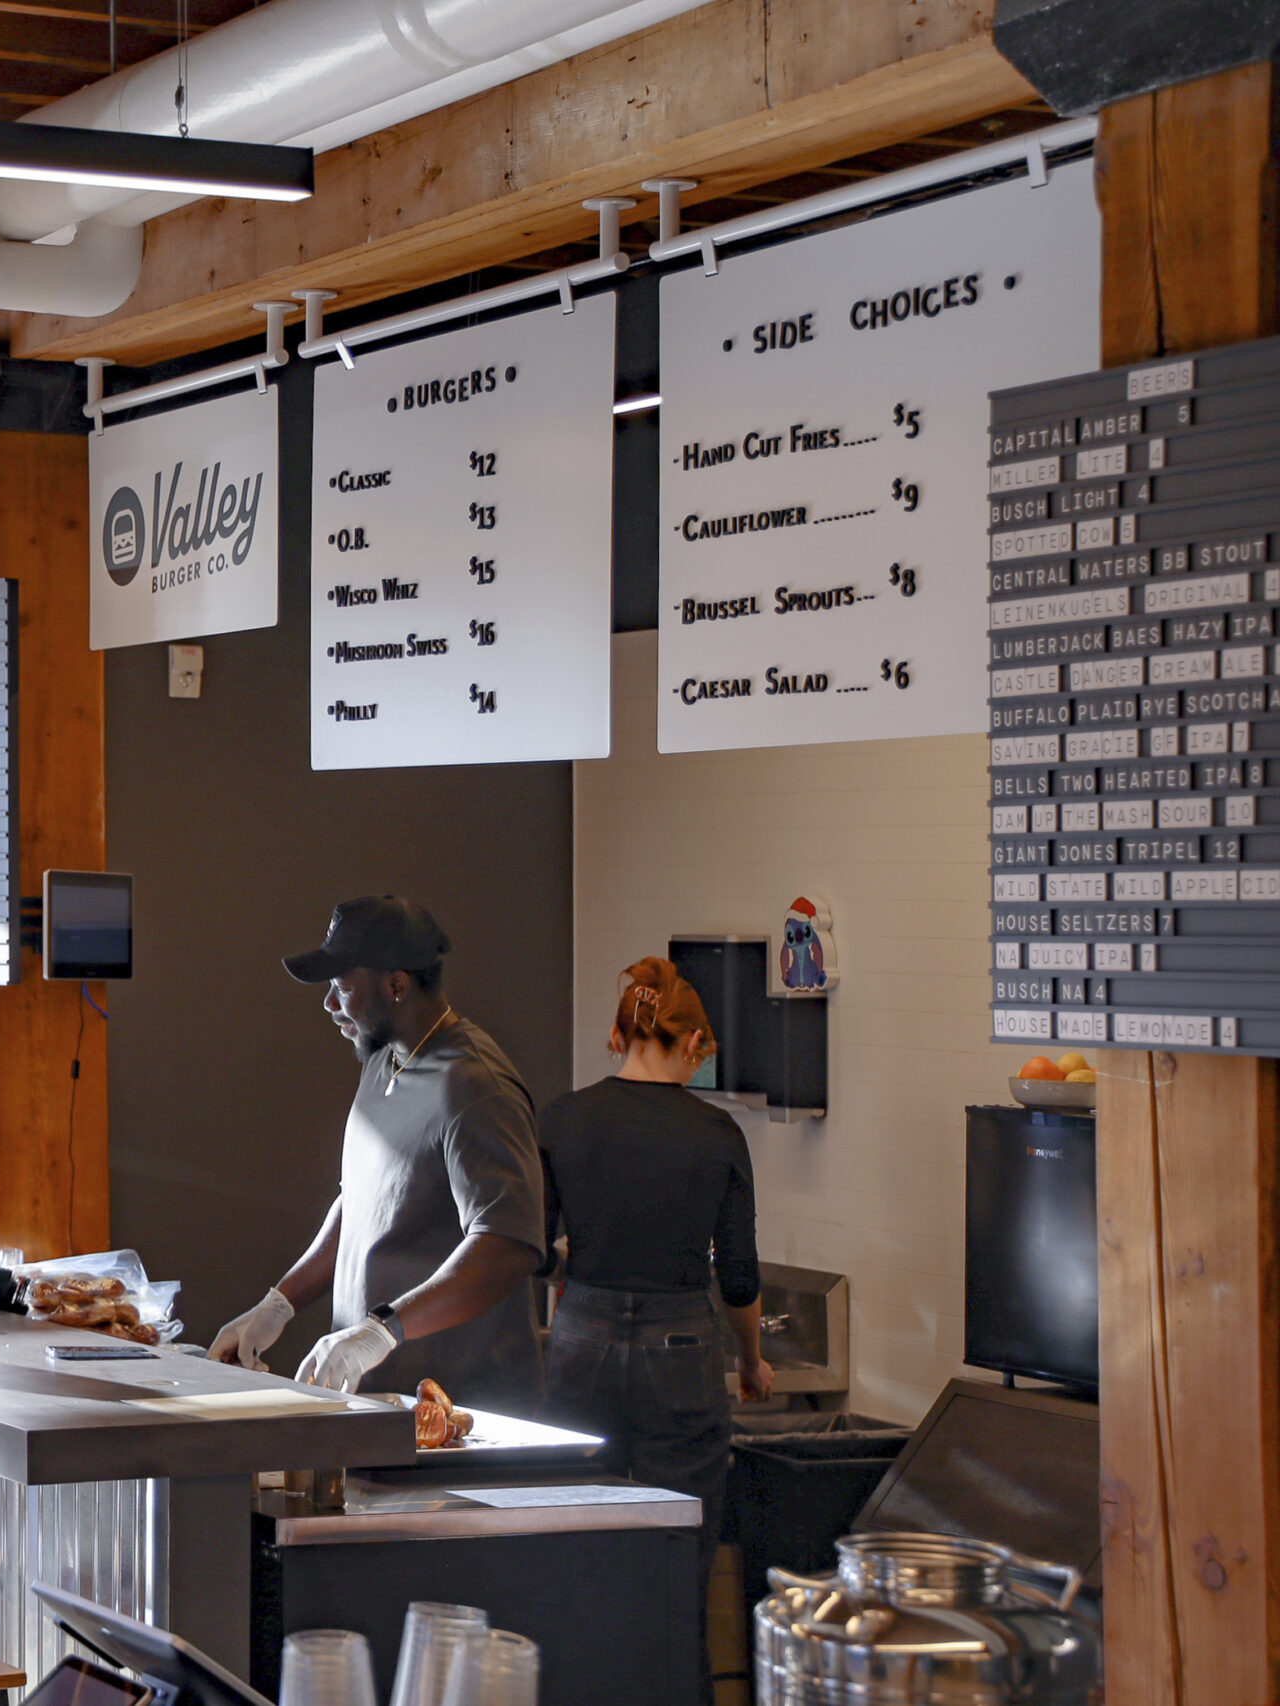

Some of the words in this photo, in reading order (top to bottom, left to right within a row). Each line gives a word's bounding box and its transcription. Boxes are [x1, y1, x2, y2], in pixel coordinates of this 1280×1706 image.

[753, 312, 814, 354] SIDE
[849, 274, 979, 331] CHOICES
[403, 366, 497, 411] BURGERS
[1129, 367, 1190, 396] BEERS
[742, 431, 783, 460] CUT
[892, 402, 921, 439] $5
[993, 427, 1073, 456] CAPITAL
[1081, 414, 1140, 440] AMBER
[1177, 405, 1189, 423] 5
[469, 450, 496, 478] $12
[992, 463, 1058, 486] MILLER
[1079, 452, 1124, 476] LITE
[1151, 447, 1161, 462] 4
[891, 477, 919, 512] $9
[991, 498, 1047, 524] BUSCH
[1060, 488, 1118, 514] LIGHT
[1137, 484, 1148, 501] 4
[151, 460, 264, 569] Valley
[336, 527, 370, 553] O.B.
[468, 502, 496, 530] $13
[993, 530, 1070, 557] SPOTTED
[1079, 525, 1112, 546] COW
[1122, 521, 1133, 539] 5
[151, 561, 201, 594] BURGER
[207, 553, 229, 575] CO.
[468, 556, 495, 585] $15
[888, 562, 916, 598] $8
[992, 565, 1068, 591] CENTRAL
[1079, 555, 1149, 580] WATERS
[1162, 551, 1187, 571] BB
[1200, 540, 1265, 566] STOUT
[992, 593, 1127, 626] LEINENKUGELS
[1146, 579, 1245, 608] ORIGINAL
[468, 619, 495, 647] $16
[992, 632, 1104, 660] LUMBERJACK
[1112, 626, 1161, 648] BAES
[1173, 619, 1223, 641] HAZY
[1233, 615, 1272, 636] IPA
[764, 666, 829, 695] SALAD
[880, 658, 910, 690] $6
[993, 671, 1057, 693] CASTLE
[1071, 664, 1141, 686] DANGER
[1152, 659, 1212, 680] CREAM
[1223, 653, 1260, 673] ALE
[469, 683, 497, 714] $14
[992, 705, 1069, 728] BUFFALO
[1077, 700, 1135, 721] PLAID
[1141, 697, 1176, 716] RYE
[1187, 690, 1263, 714] SCOTCH
[993, 741, 1057, 761] SAVING
[1068, 736, 1135, 756] GRACIE
[1152, 733, 1175, 752] GF
[1191, 731, 1225, 749] IPA
[1236, 729, 1246, 747] 7
[994, 776, 1048, 796] BELLS
[1061, 774, 1095, 792] TWO
[1104, 769, 1189, 791] HEARTED
[1204, 766, 1241, 786] IPA
[1250, 765, 1262, 784] 8
[994, 812, 1026, 829] JAM
[1034, 811, 1055, 828] UP
[1064, 809, 1097, 826] THE
[1105, 806, 1151, 824] MASH
[1161, 805, 1208, 823] SOUR
[1229, 803, 1251, 821] 10
[994, 845, 1047, 864] GIANT
[1059, 844, 1115, 862] JONES
[1126, 841, 1198, 861] TRIPEL
[1214, 840, 1238, 858] 12
[995, 880, 1038, 898] WILD
[1048, 879, 1104, 897] STATE
[1116, 879, 1162, 896] WILD
[1174, 878, 1235, 895] APPLE
[996, 914, 1052, 932] HOUSE
[1060, 914, 1154, 932] SELTZERS
[1161, 914, 1171, 932] 7
[997, 947, 1018, 963] NA
[1031, 947, 1085, 965] JUICY
[1097, 949, 1130, 966] IPA
[1143, 950, 1153, 965] 7
[997, 982, 1050, 1000] BUSCH
[1062, 983, 1083, 1001] NA
[1095, 984, 1105, 1001] 4
[996, 1015, 1049, 1034] HOUSE
[1060, 1018, 1104, 1037] MADE
[1116, 1020, 1209, 1042] LEMONADE
[1222, 1025, 1233, 1041] 4
